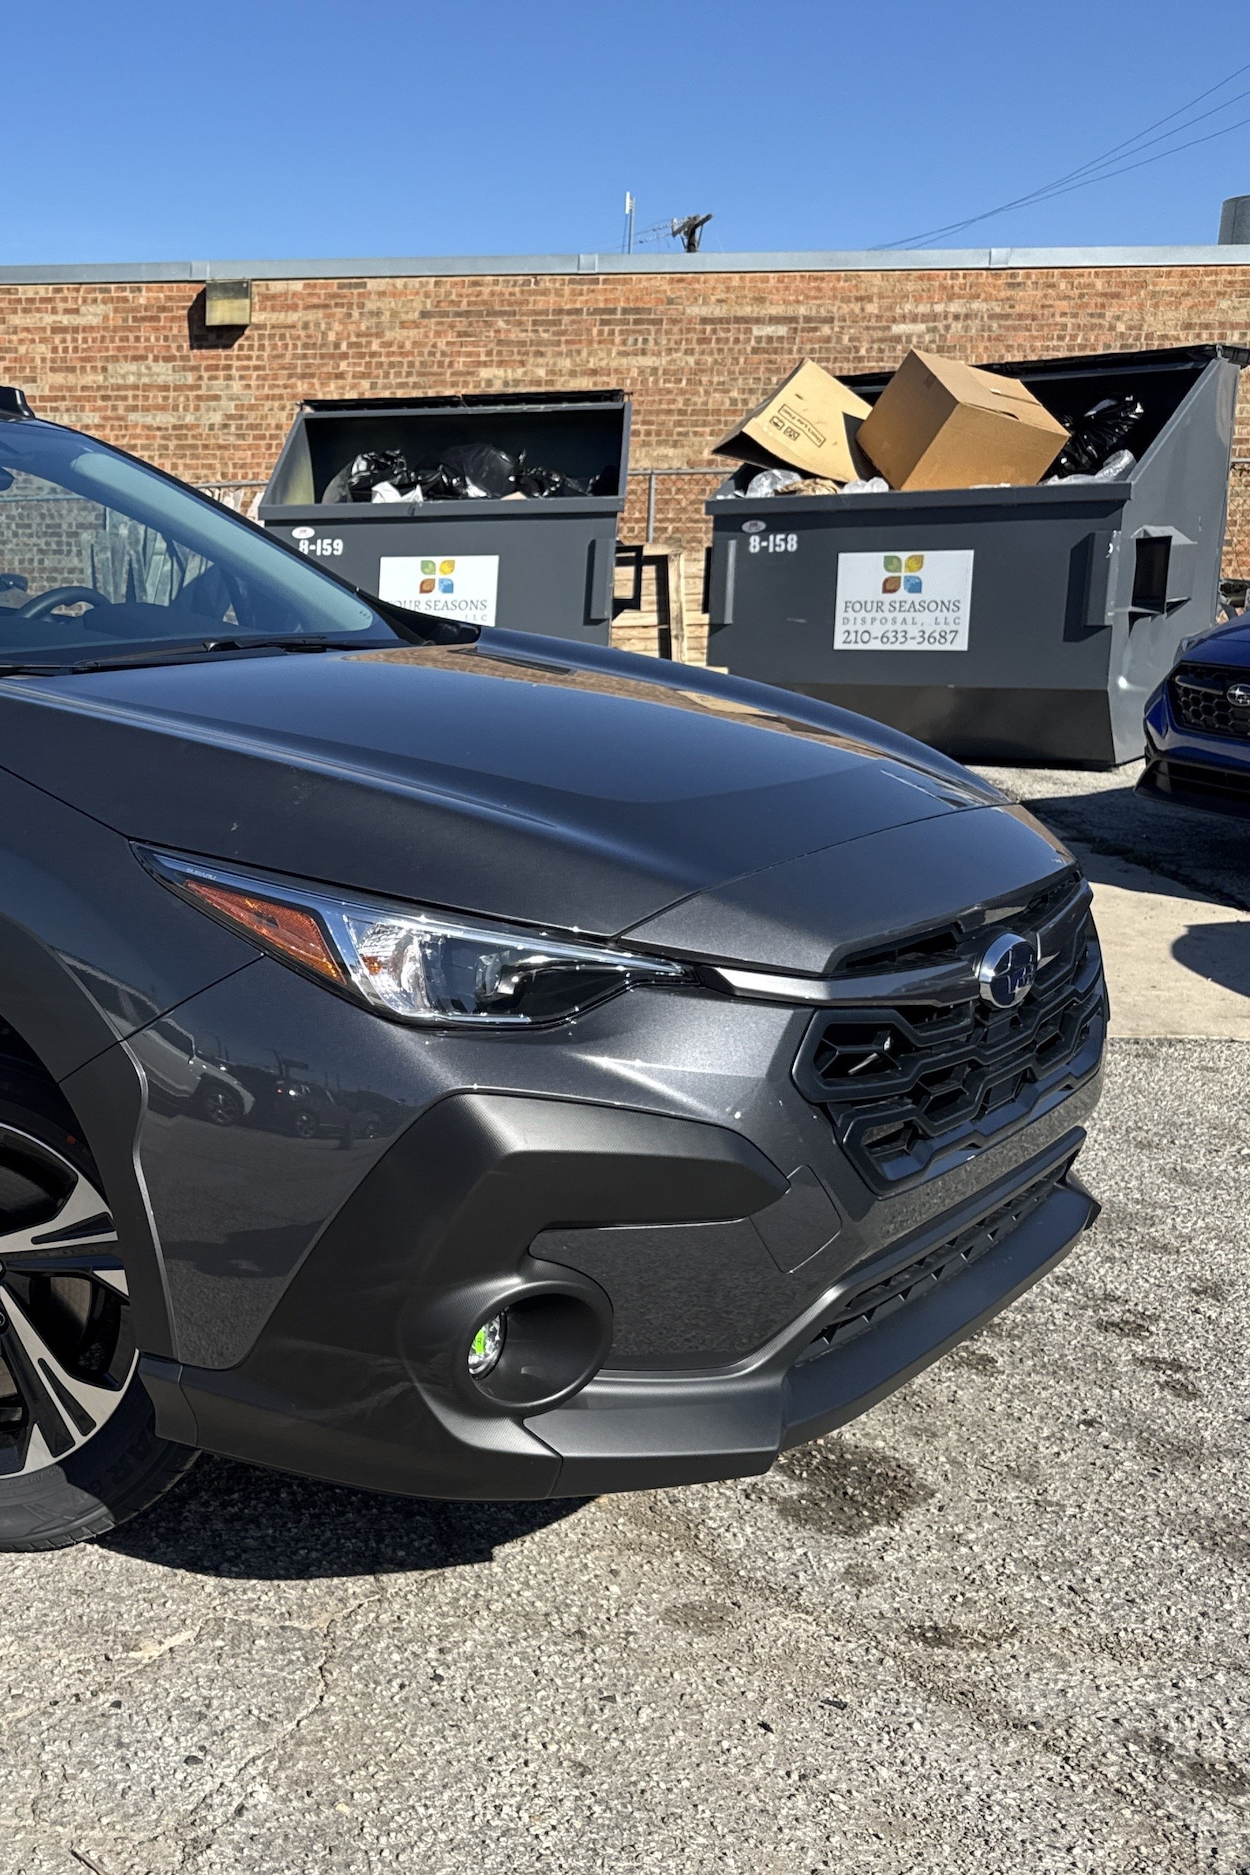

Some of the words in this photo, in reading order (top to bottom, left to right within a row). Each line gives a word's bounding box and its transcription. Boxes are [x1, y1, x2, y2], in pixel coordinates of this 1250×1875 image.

[298, 538, 344, 556] 8-159
[748, 533, 798, 553] 8-158
[388, 600, 422, 611] OUR
[424, 599, 488, 611] SEASONS
[843, 600, 885, 613] FOUR
[888, 599, 961, 613] SEASONS
[842, 616, 925, 627] DISPOSAL,
[934, 616, 961, 626] LLC
[842, 629, 959, 645] 210-633-3687
